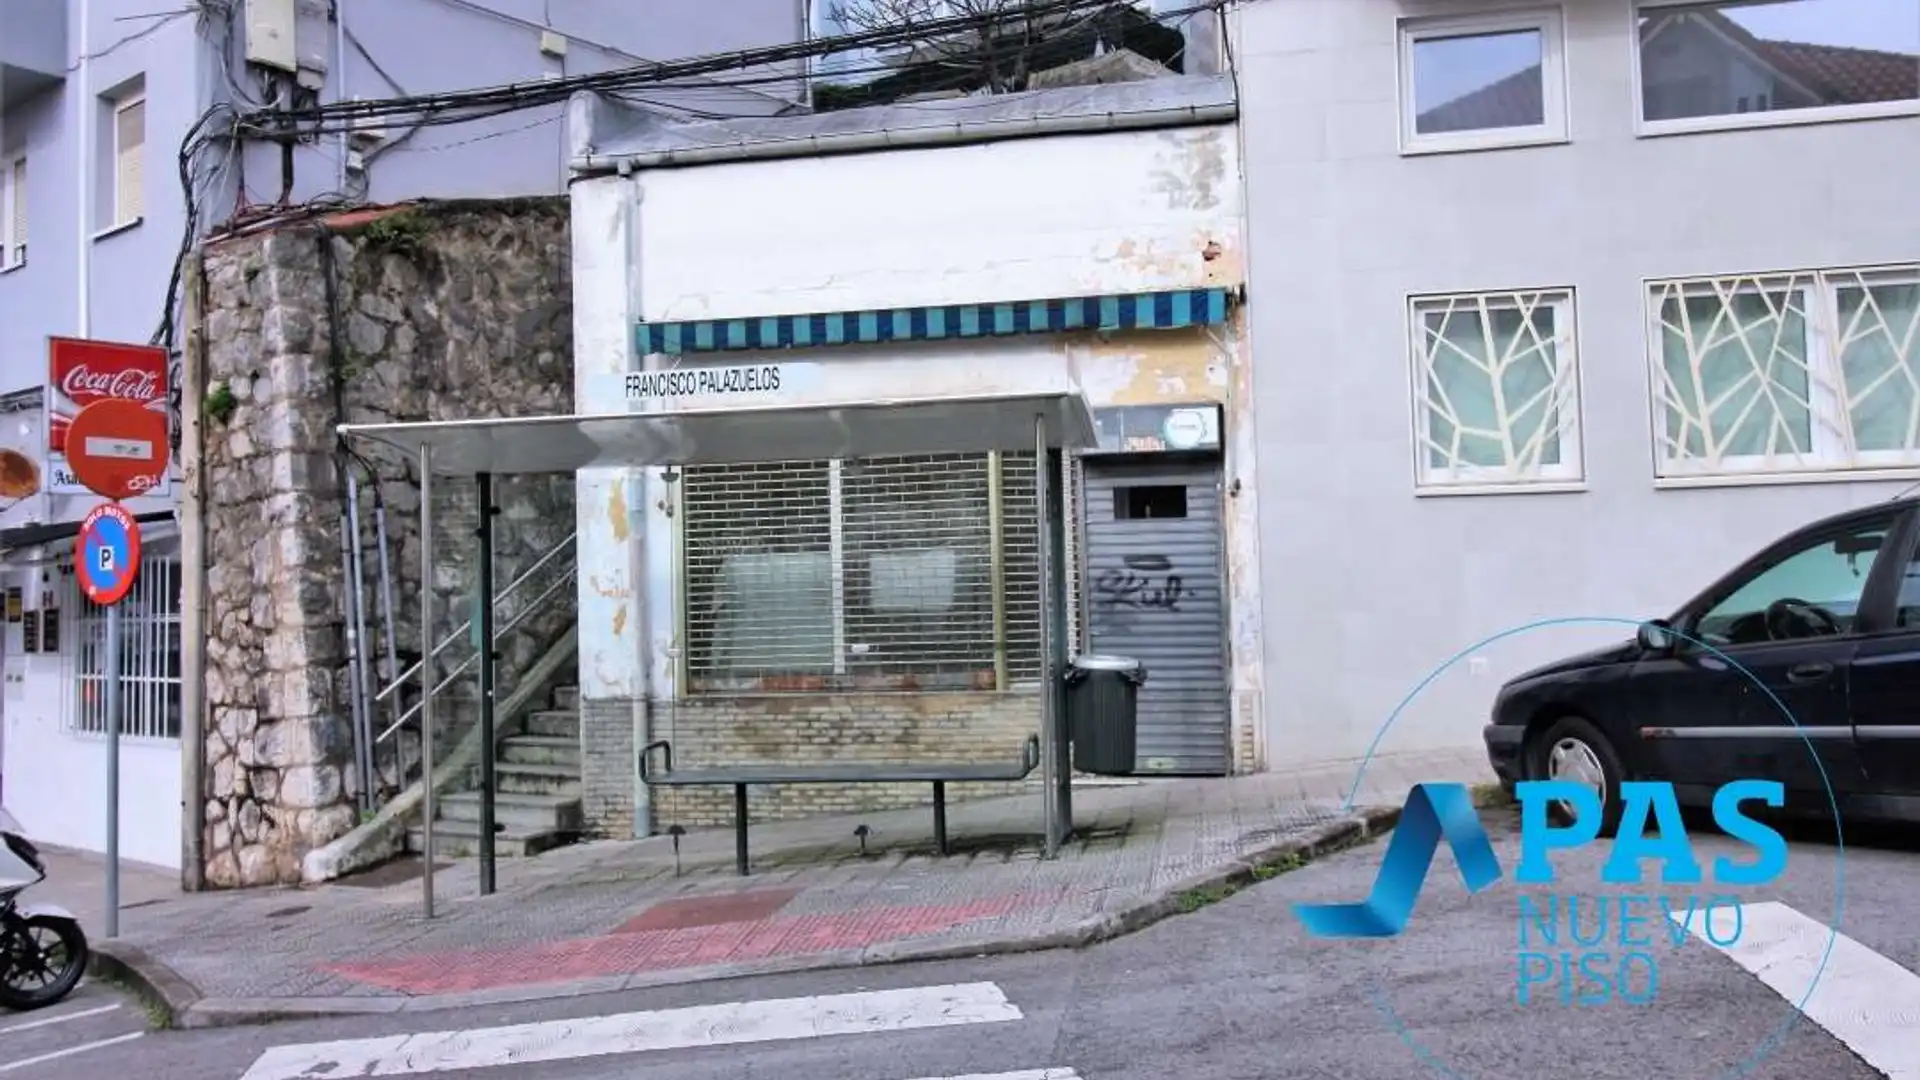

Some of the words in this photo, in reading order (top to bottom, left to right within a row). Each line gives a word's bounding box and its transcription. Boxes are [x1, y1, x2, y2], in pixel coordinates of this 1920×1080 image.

[62, 363, 159, 399] Coca-Cola
[625, 371, 696, 397] FRANCISCO
[700, 366, 780, 393] PALAZUELOS
[101, 549, 111, 568] P
